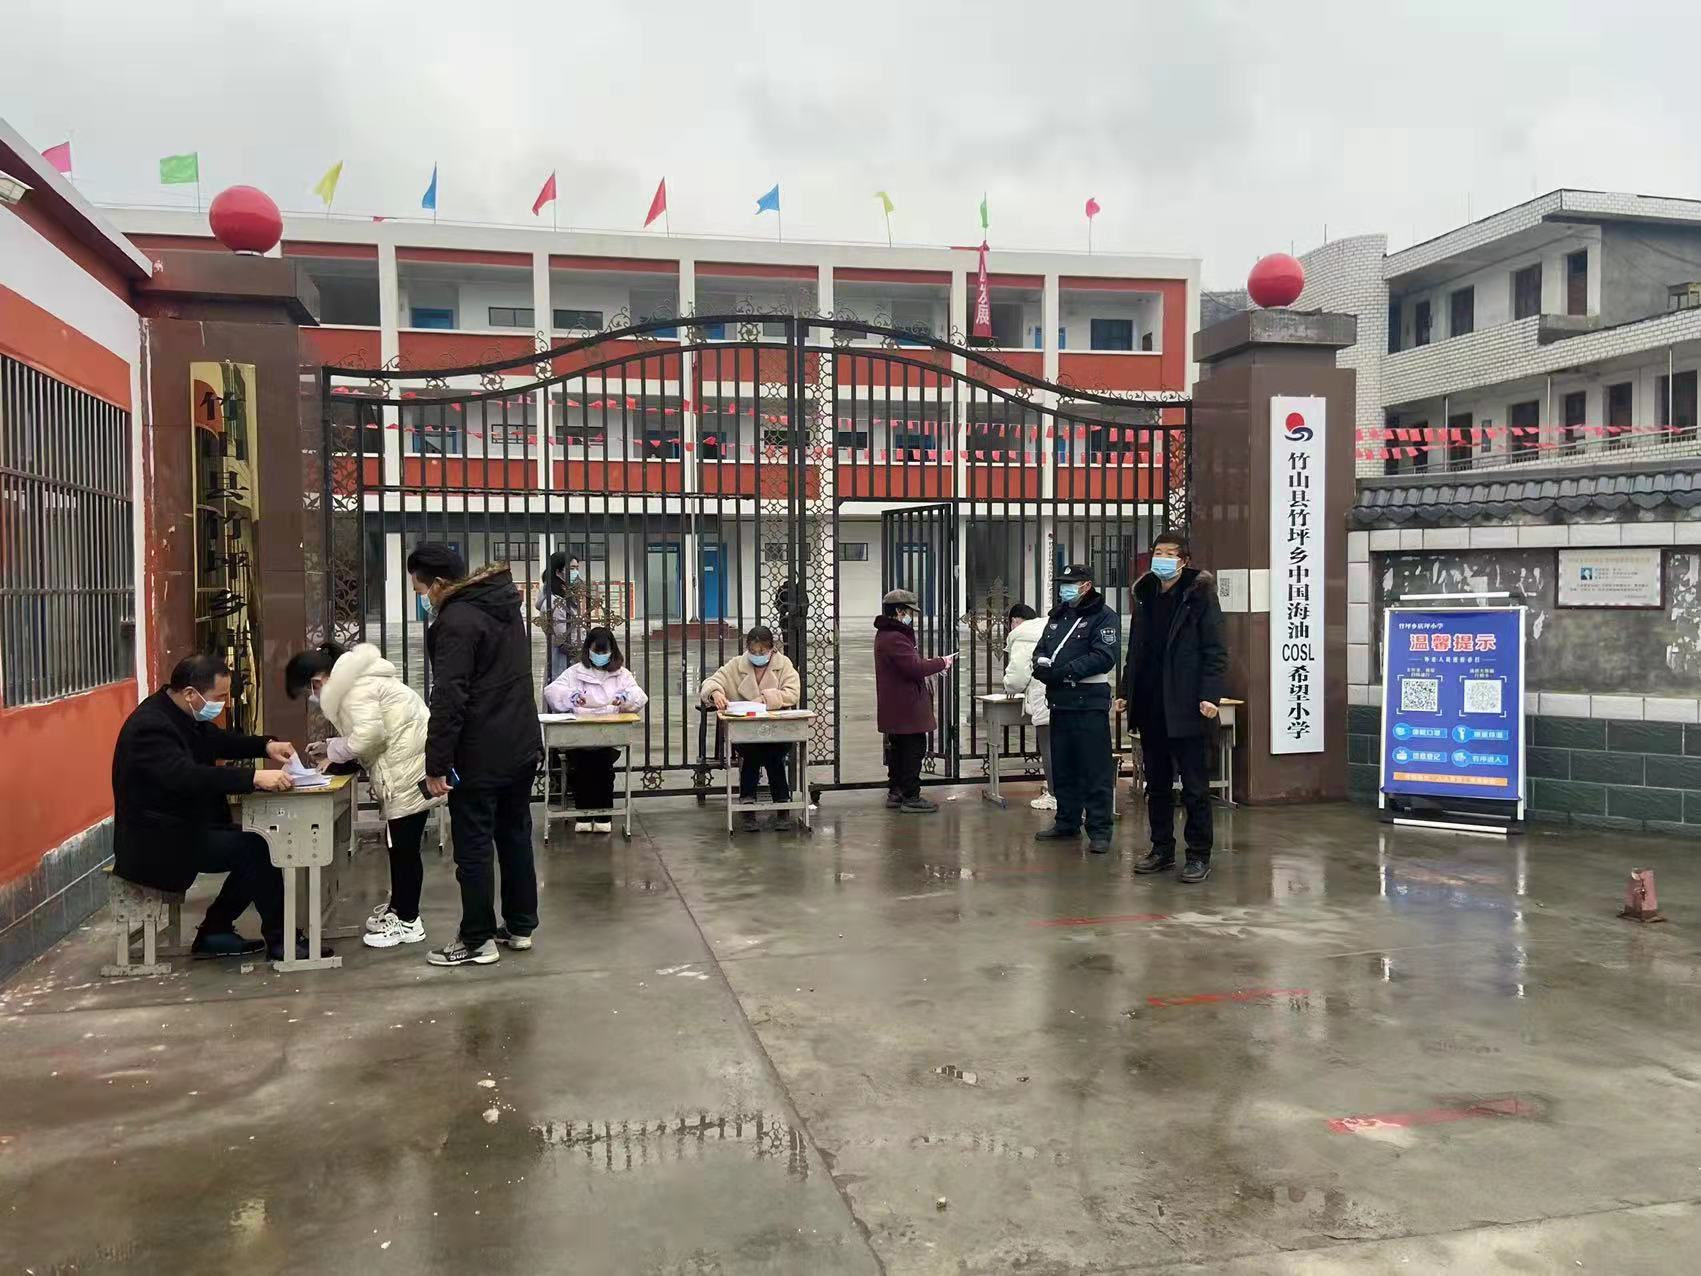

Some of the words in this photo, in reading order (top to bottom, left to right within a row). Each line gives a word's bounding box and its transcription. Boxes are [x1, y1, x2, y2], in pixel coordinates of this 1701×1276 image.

[1282, 452, 1316, 740] 竹山县竹坪乡中国海油COSL希望小学
[1409, 633, 1497, 652] 温馨提示
